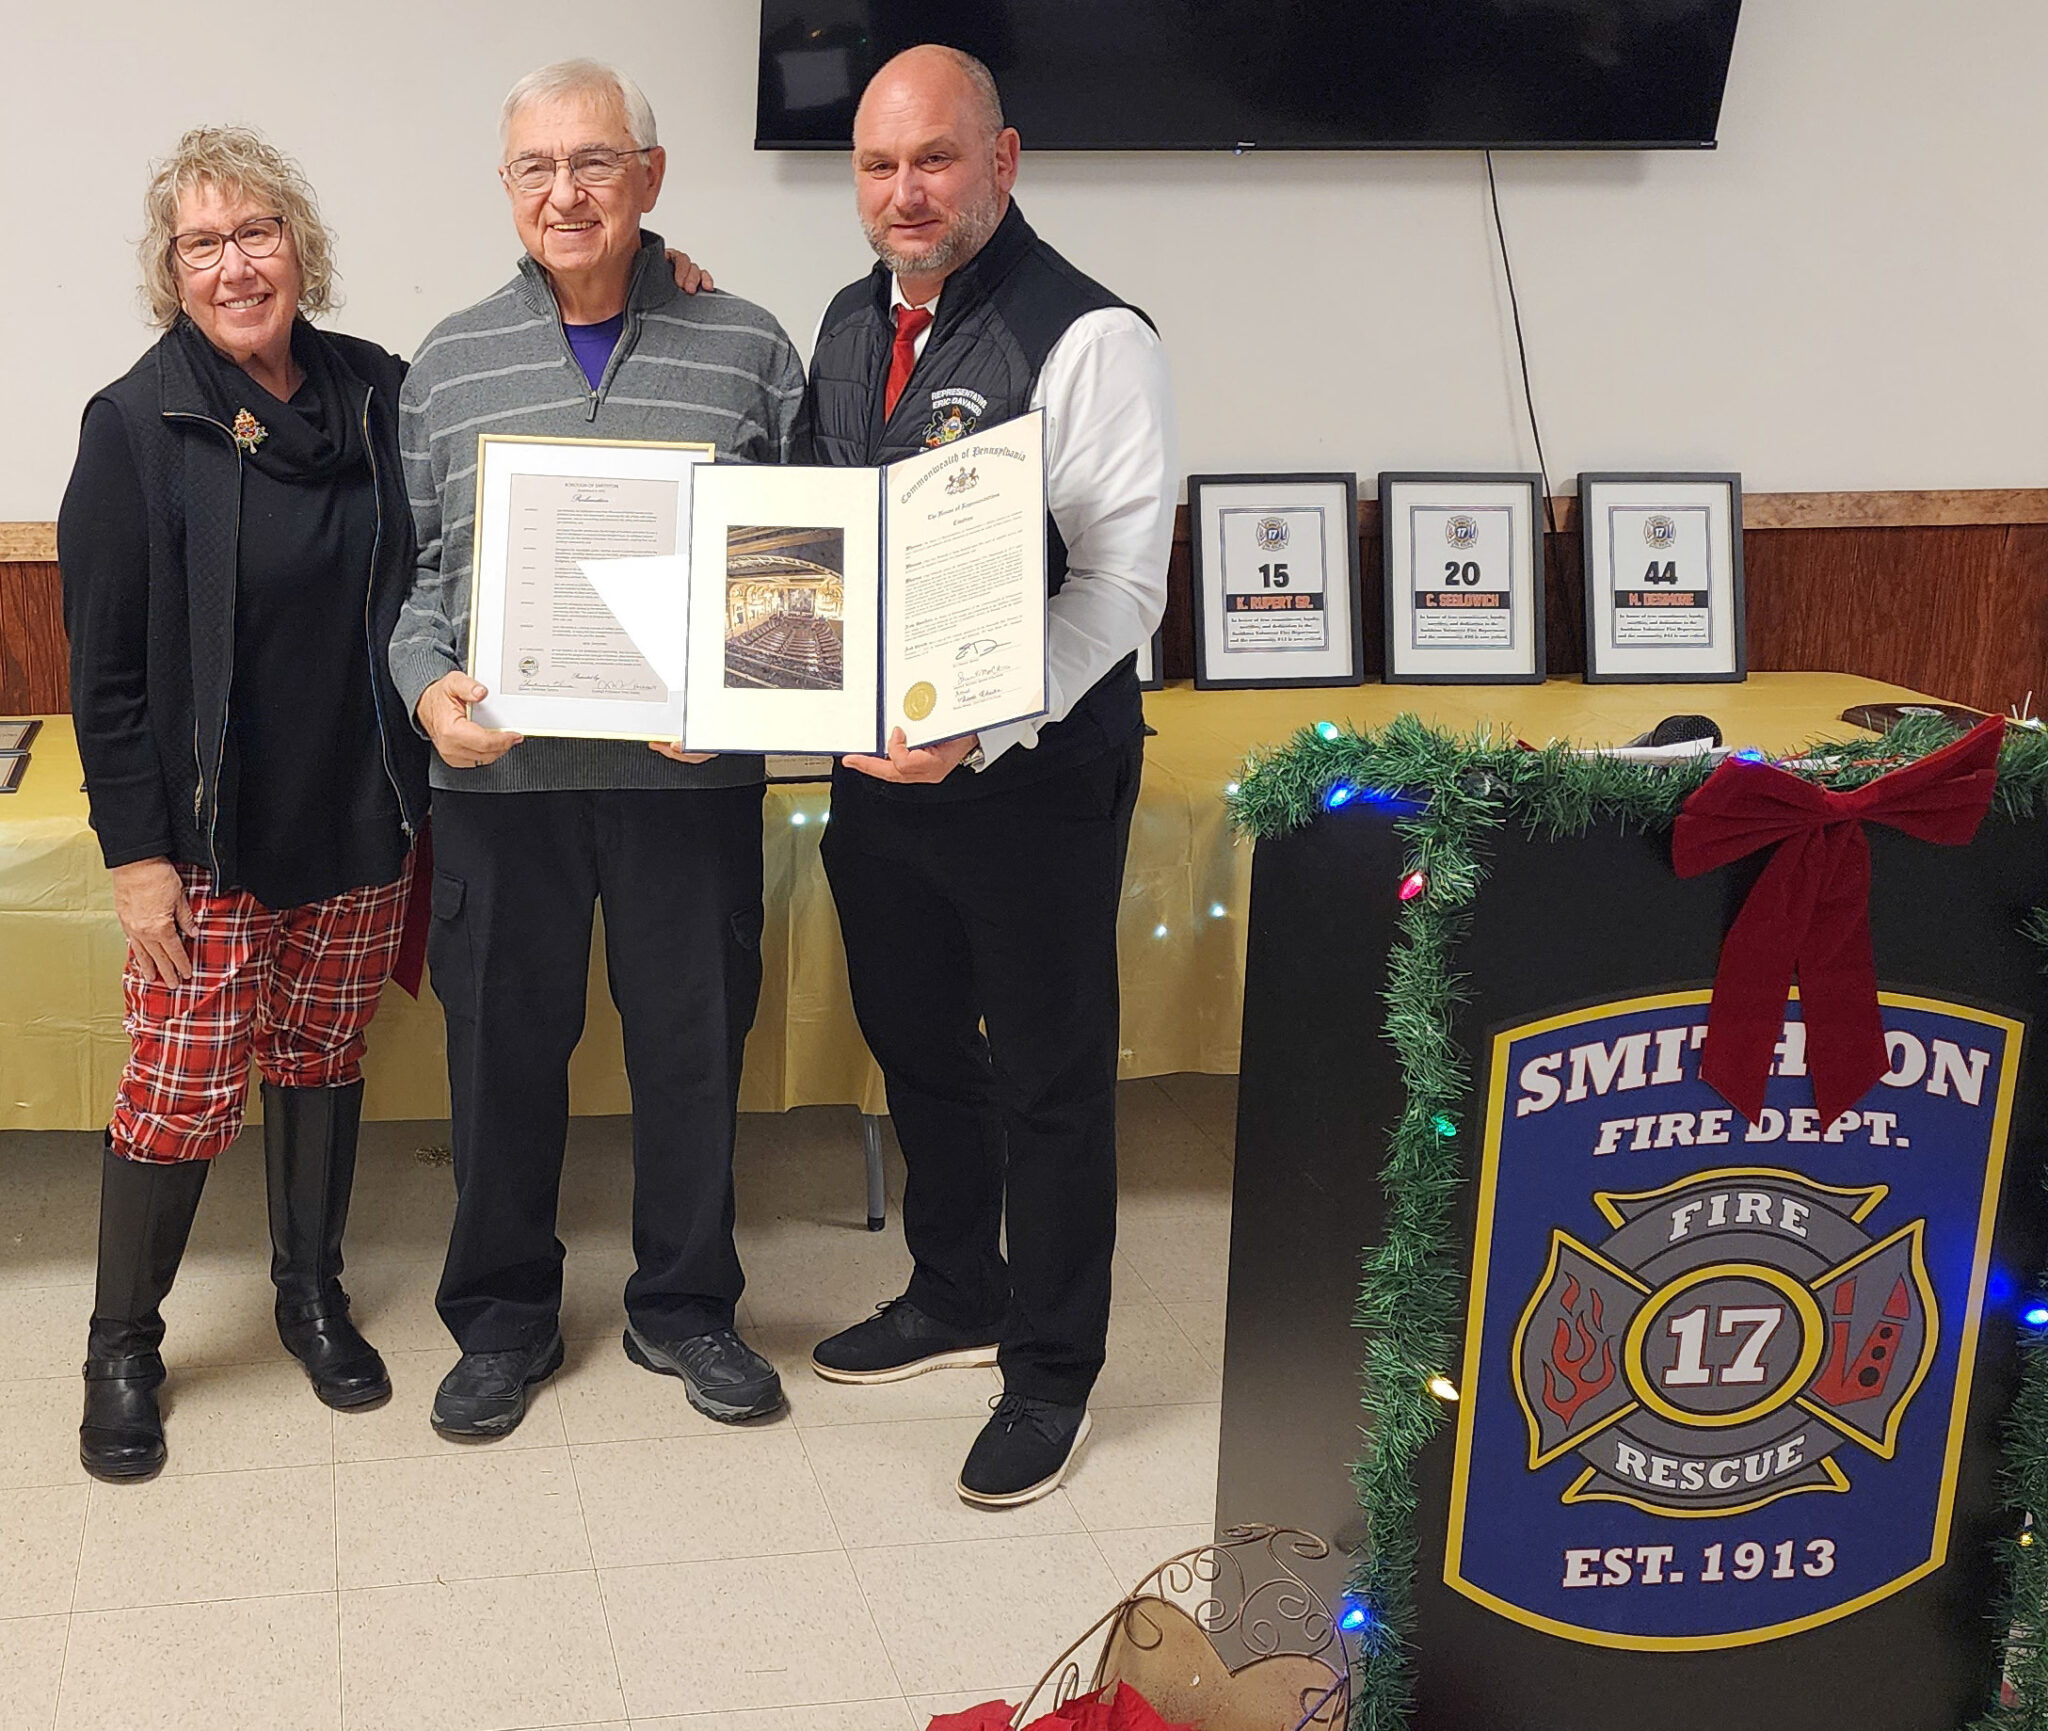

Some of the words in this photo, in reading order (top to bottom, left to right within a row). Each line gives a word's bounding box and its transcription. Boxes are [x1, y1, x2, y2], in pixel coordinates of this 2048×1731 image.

[932, 397, 951, 410] ERIC
[901, 453, 959, 504] Commonwealth
[961, 448, 969, 460] of
[972, 446, 1026, 462] Pennsylvania
[1267, 529, 1278, 540] 17
[1456, 527, 1468, 538] 17
[1654, 527, 1665, 538] 17
[1258, 563, 1290, 588] 15
[1445, 561, 1481, 586] 20
[1644, 560, 1678, 585] 44
[1426, 593, 1437, 607] C.
[1515, 1021, 1991, 1118] SMIHON
[1593, 1109, 1730, 1156] FIRE
[1746, 1107, 1909, 1148] DEPT.
[1668, 1191, 1810, 1242] FIRE
[1661, 1304, 1786, 1388] 17
[1615, 1435, 1806, 1491] RESCUE
[1562, 1545, 1684, 1588] EST.
[1700, 1538, 1836, 1582] 1913
